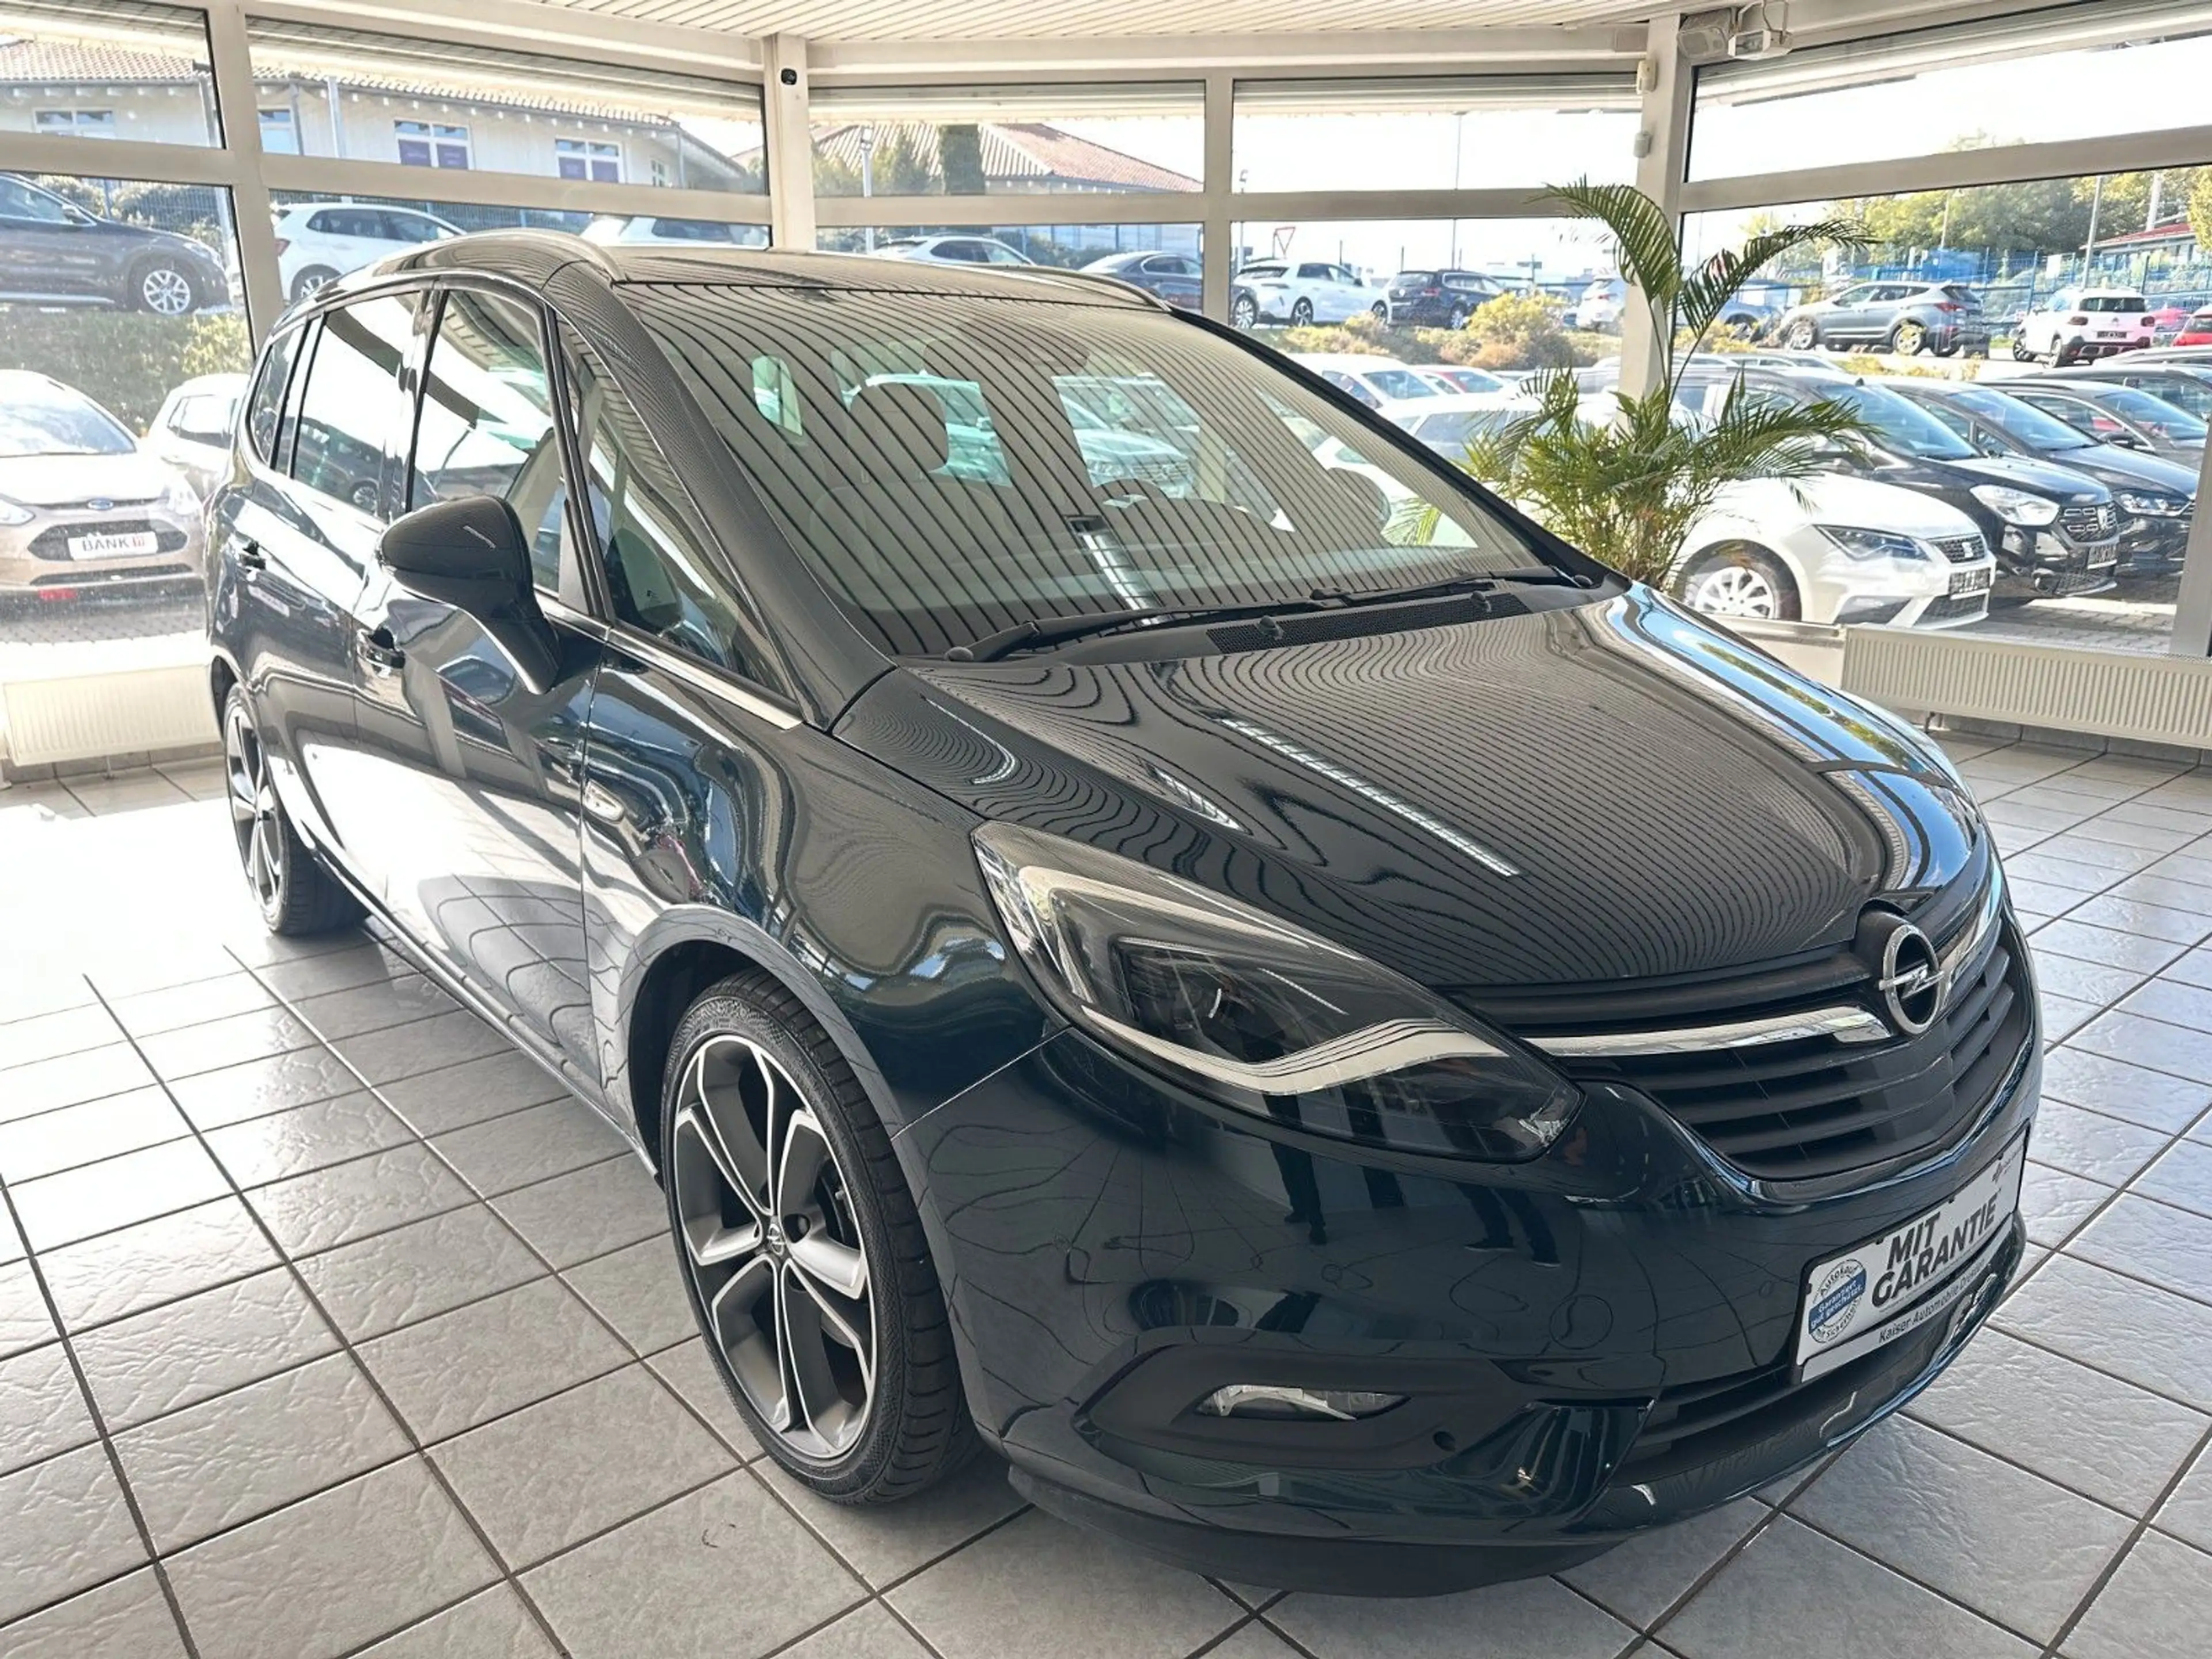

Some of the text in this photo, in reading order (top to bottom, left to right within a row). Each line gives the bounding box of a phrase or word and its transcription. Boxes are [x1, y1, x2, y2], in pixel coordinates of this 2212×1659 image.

[1872, 1192, 1998, 1307] GARANTIE
[1887, 1211, 1940, 1270] MIT
[1879, 1317, 1911, 1343] Kaiser
